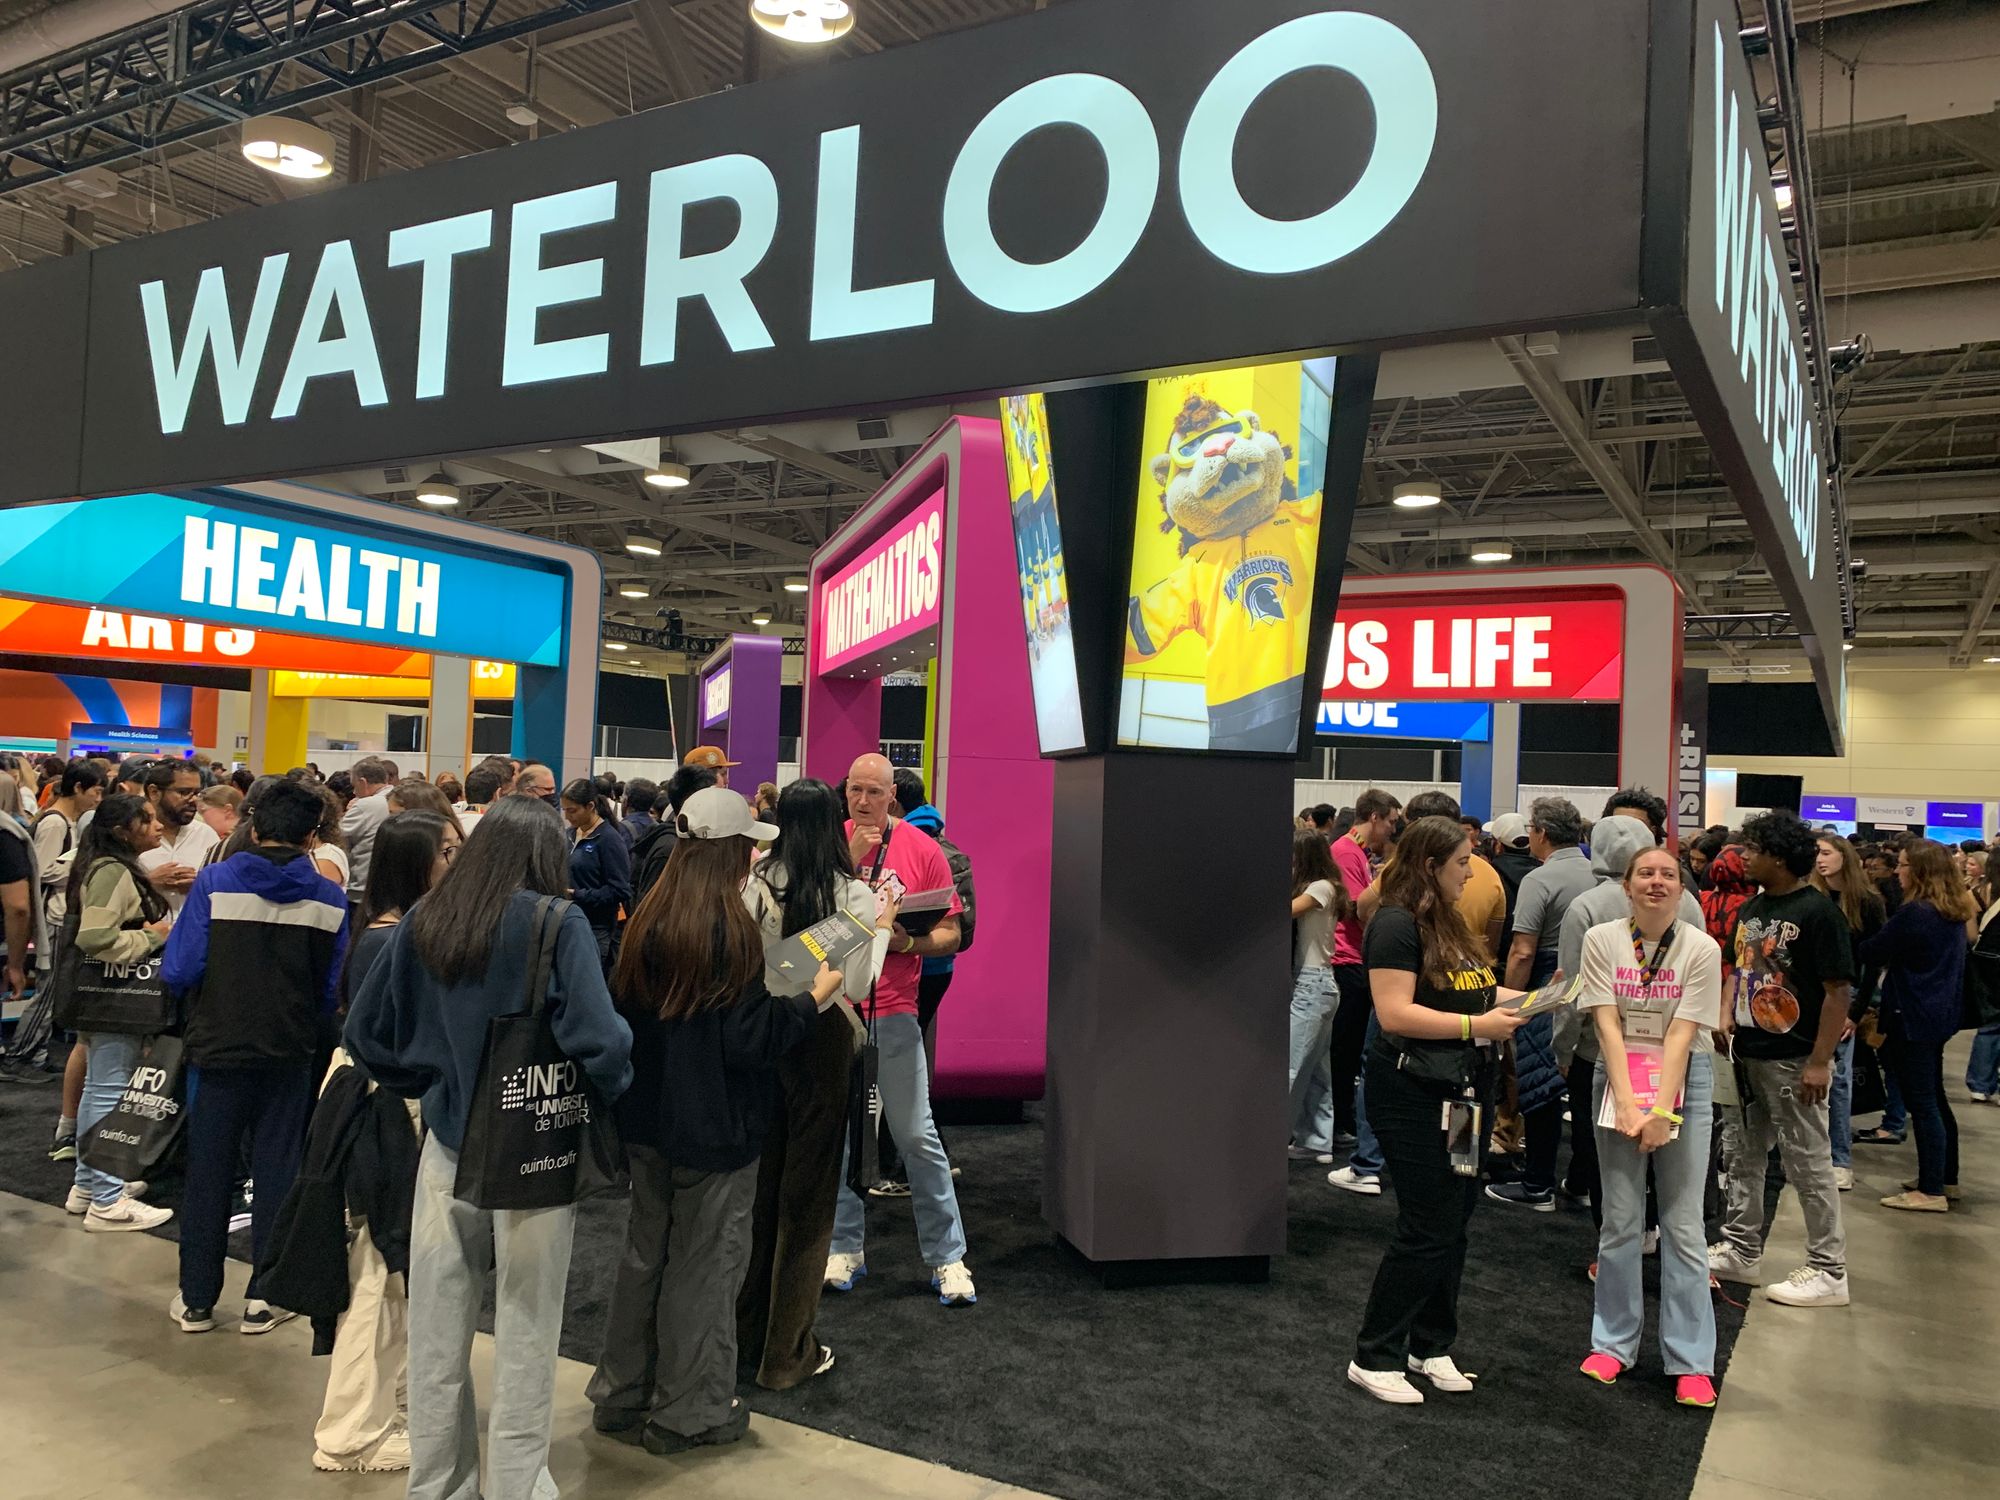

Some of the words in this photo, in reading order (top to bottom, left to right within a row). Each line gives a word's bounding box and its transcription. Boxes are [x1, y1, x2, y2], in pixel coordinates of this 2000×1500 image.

[139, 11, 1439, 435] WATERLOO
[1715, 20, 1819, 580] WATERLOO
[180, 515, 441, 637] HEALTH
[824, 510, 941, 660] MATHEMATICS
[1223, 558, 1294, 604] WARRIORS
[1413, 616, 1552, 688] LIFE
[131, 732, 159, 740] Sciences
[1868, 806, 1904, 815] Western
[104, 961, 152, 980] INFO
[525, 1060, 577, 1099] INFO
[535, 1115, 550, 1132] de
[519, 1150, 577, 1176] ouinfo.ca/fr
